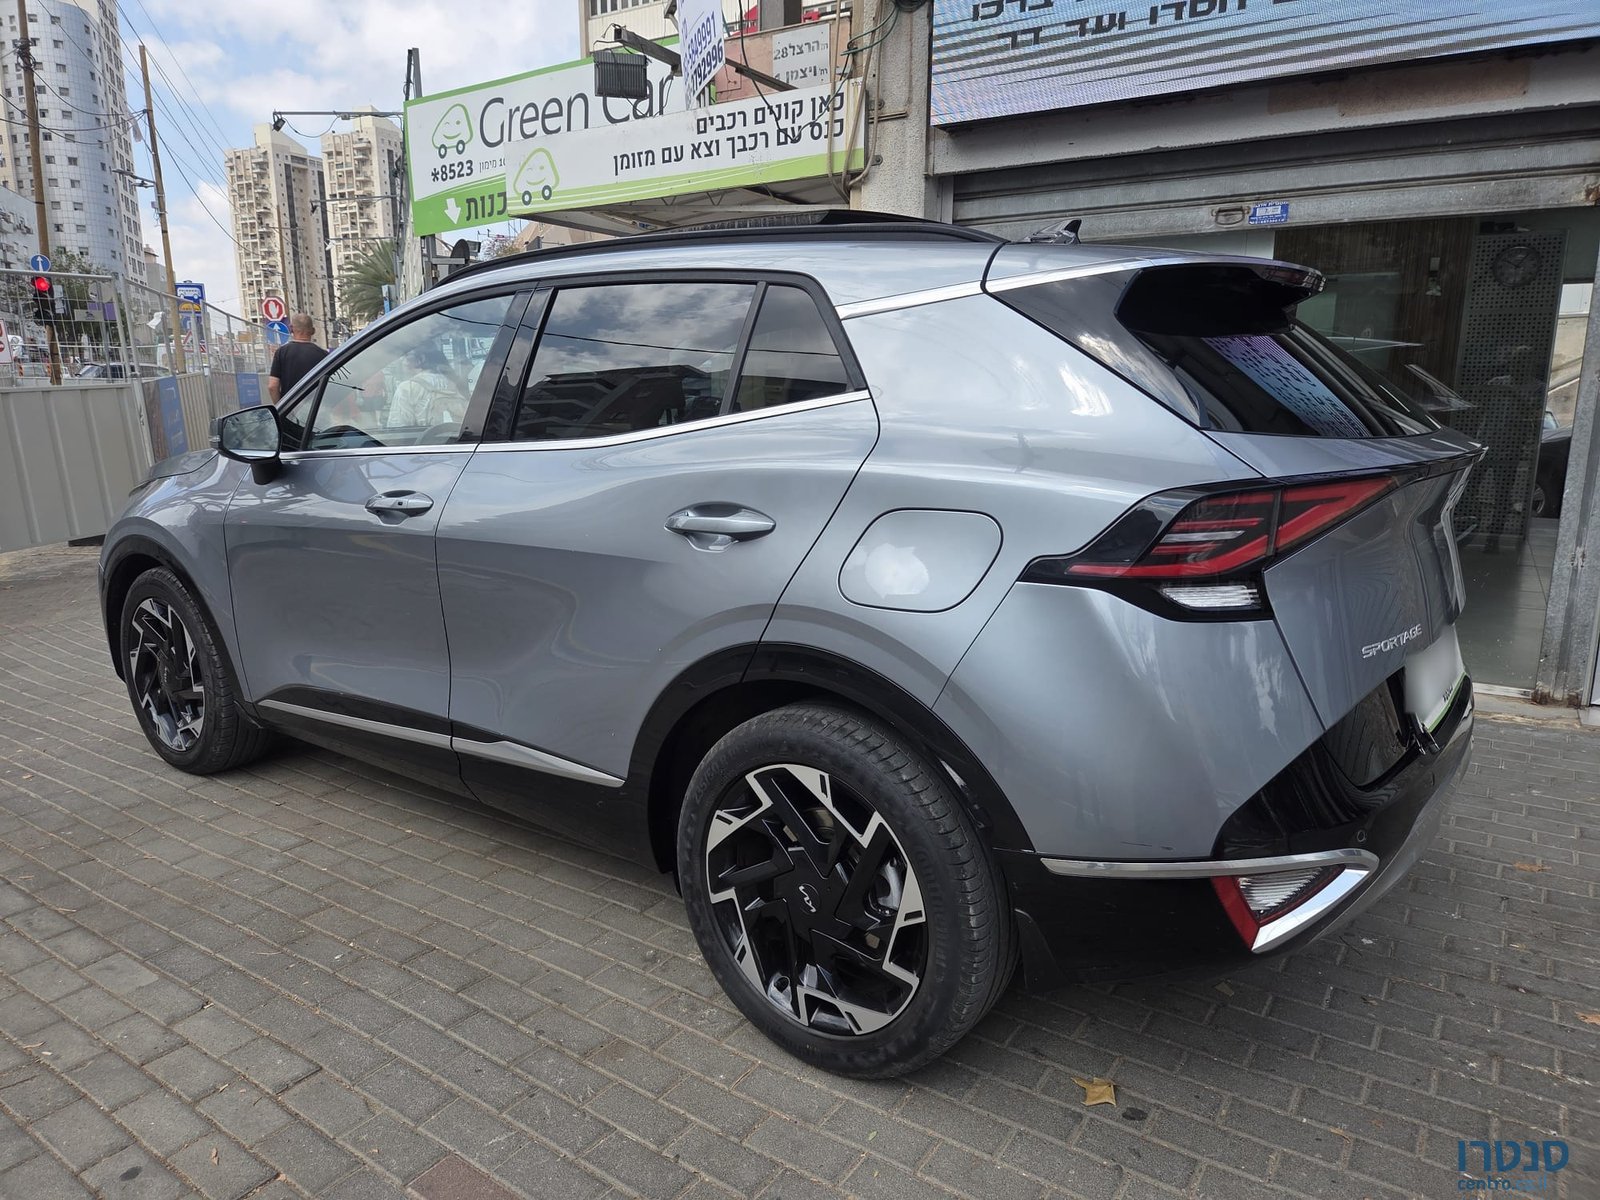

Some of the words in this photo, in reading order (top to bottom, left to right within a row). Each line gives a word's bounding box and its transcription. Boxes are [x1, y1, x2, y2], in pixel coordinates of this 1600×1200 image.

[785, 65, 817, 84] ויצמן
[754, 100, 804, 124] קונים
[811, 92, 844, 120] כאן
[479, 92, 590, 149] Green
[696, 110, 746, 134] רכבים
[810, 118, 844, 141] כנס
[726, 131, 769, 159] רכבך
[776, 125, 802, 147] עם
[661, 145, 684, 164] עם
[690, 138, 720, 160] וצא
[613, 149, 656, 176] מזומן
[1361, 623, 1423, 659] SPORTAGE
